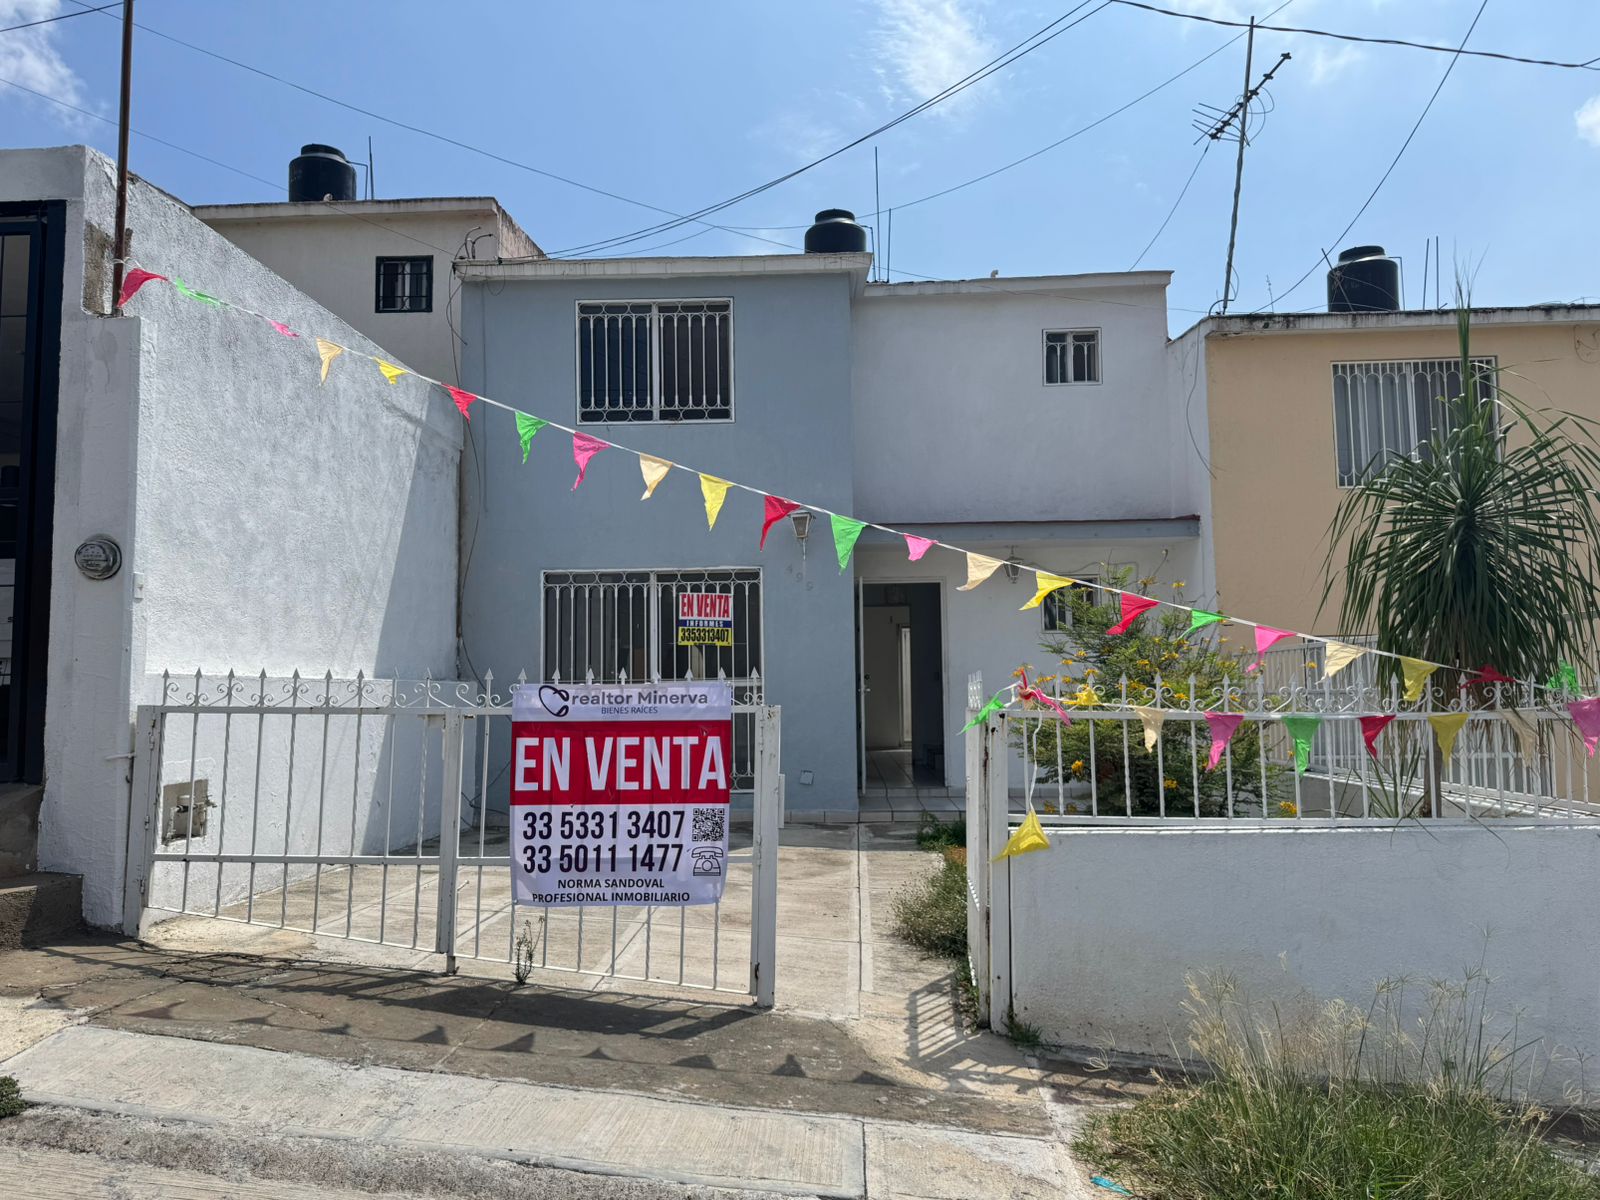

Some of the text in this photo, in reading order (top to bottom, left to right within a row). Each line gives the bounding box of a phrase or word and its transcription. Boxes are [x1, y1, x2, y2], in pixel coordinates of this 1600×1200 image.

[681, 593, 731, 618] EN VENTA
[680, 628, 729, 642] 3353313407
[572, 691, 708, 706] realtor Minerva
[601, 704, 659, 715] BIENES RAÍCES
[514, 736, 727, 791] EN VENTA
[523, 810, 685, 840] 33 5331 3407
[523, 843, 684, 873] 33 5011 1477
[557, 878, 665, 889] NORMA SANDOVAL
[532, 892, 690, 904] PROFESIONAL INMOBILIARIO
